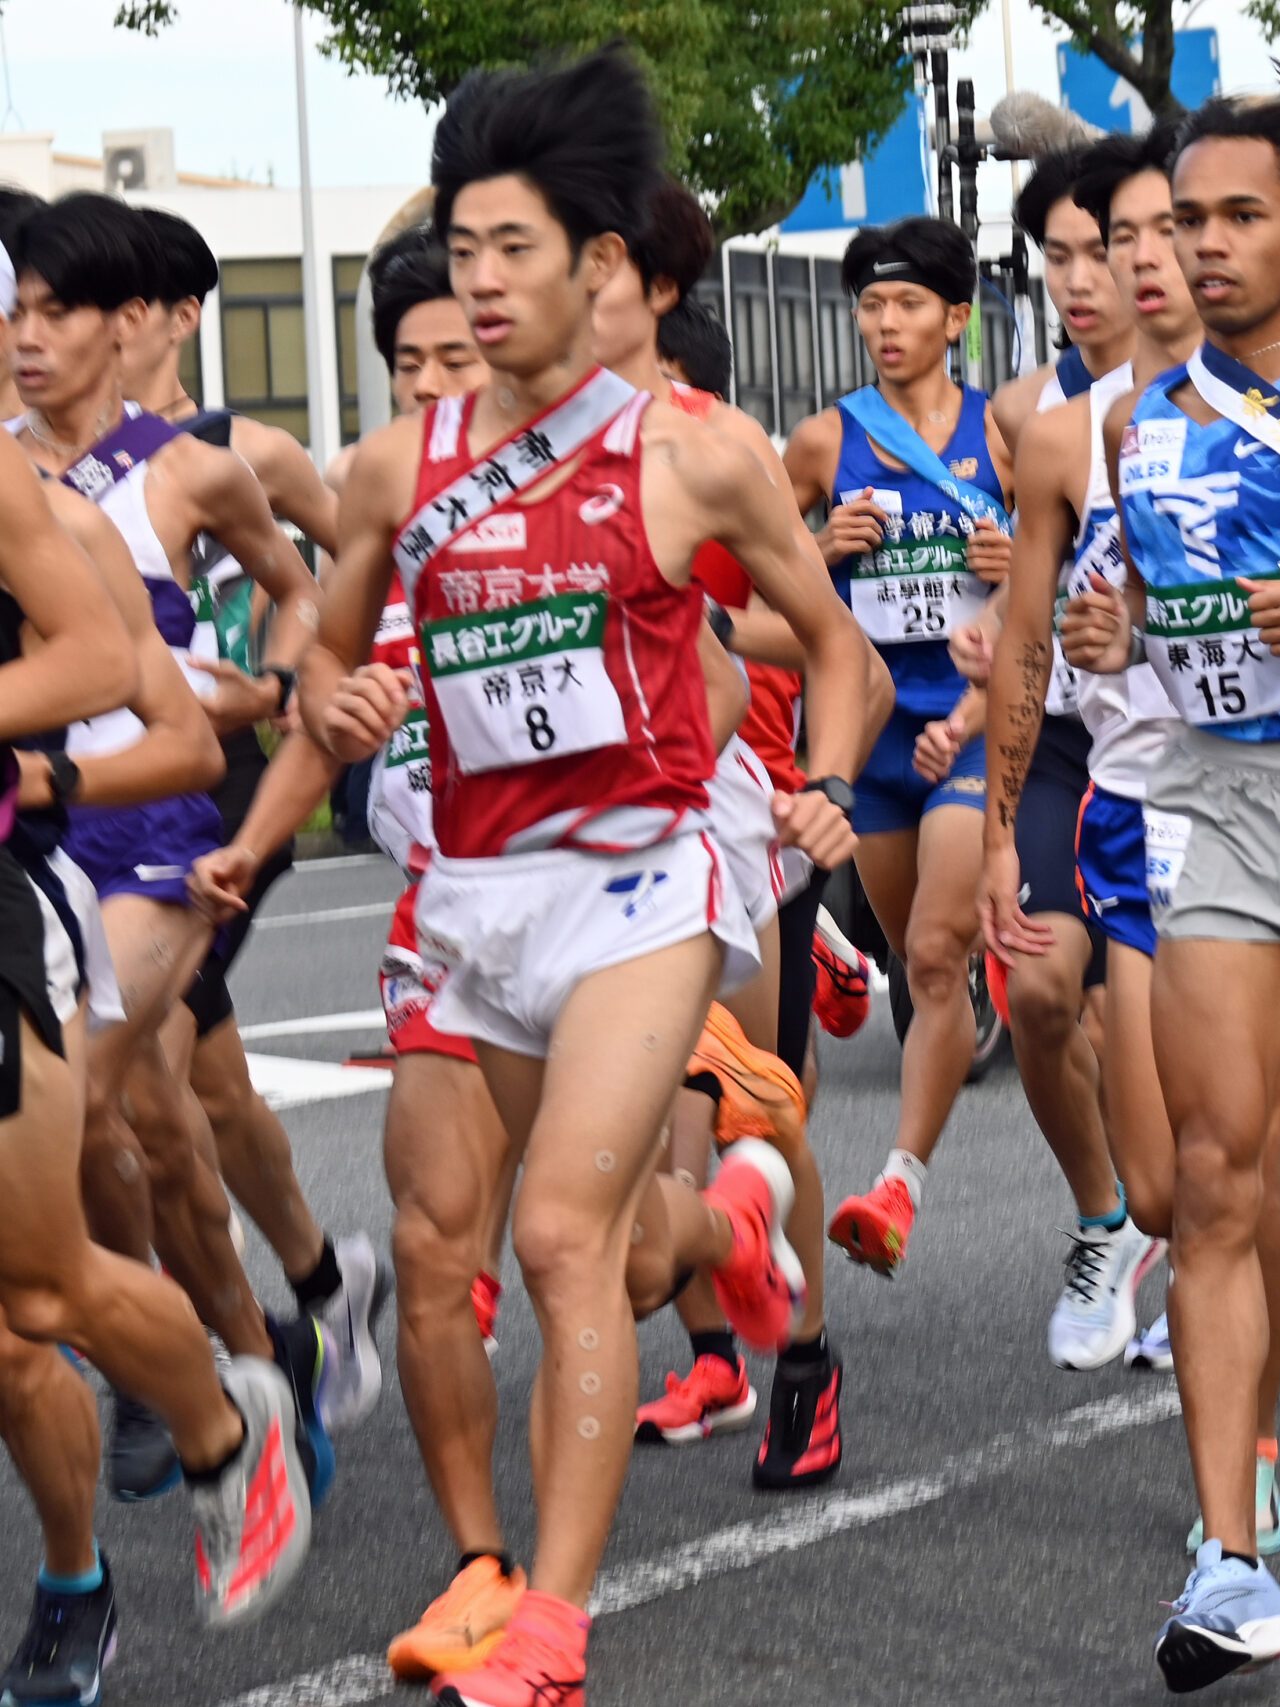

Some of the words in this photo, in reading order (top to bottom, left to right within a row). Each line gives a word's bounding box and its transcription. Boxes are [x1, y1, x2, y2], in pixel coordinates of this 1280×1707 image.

[438, 561, 611, 616] 帝京大学
[431, 602, 599, 670] 長谷工グループ
[902, 600, 946, 634] 25
[1167, 635, 1264, 673] 東海大
[481, 655, 584, 707] 帝京大
[1194, 671, 1247, 717] 15
[525, 704, 556, 752] 8
